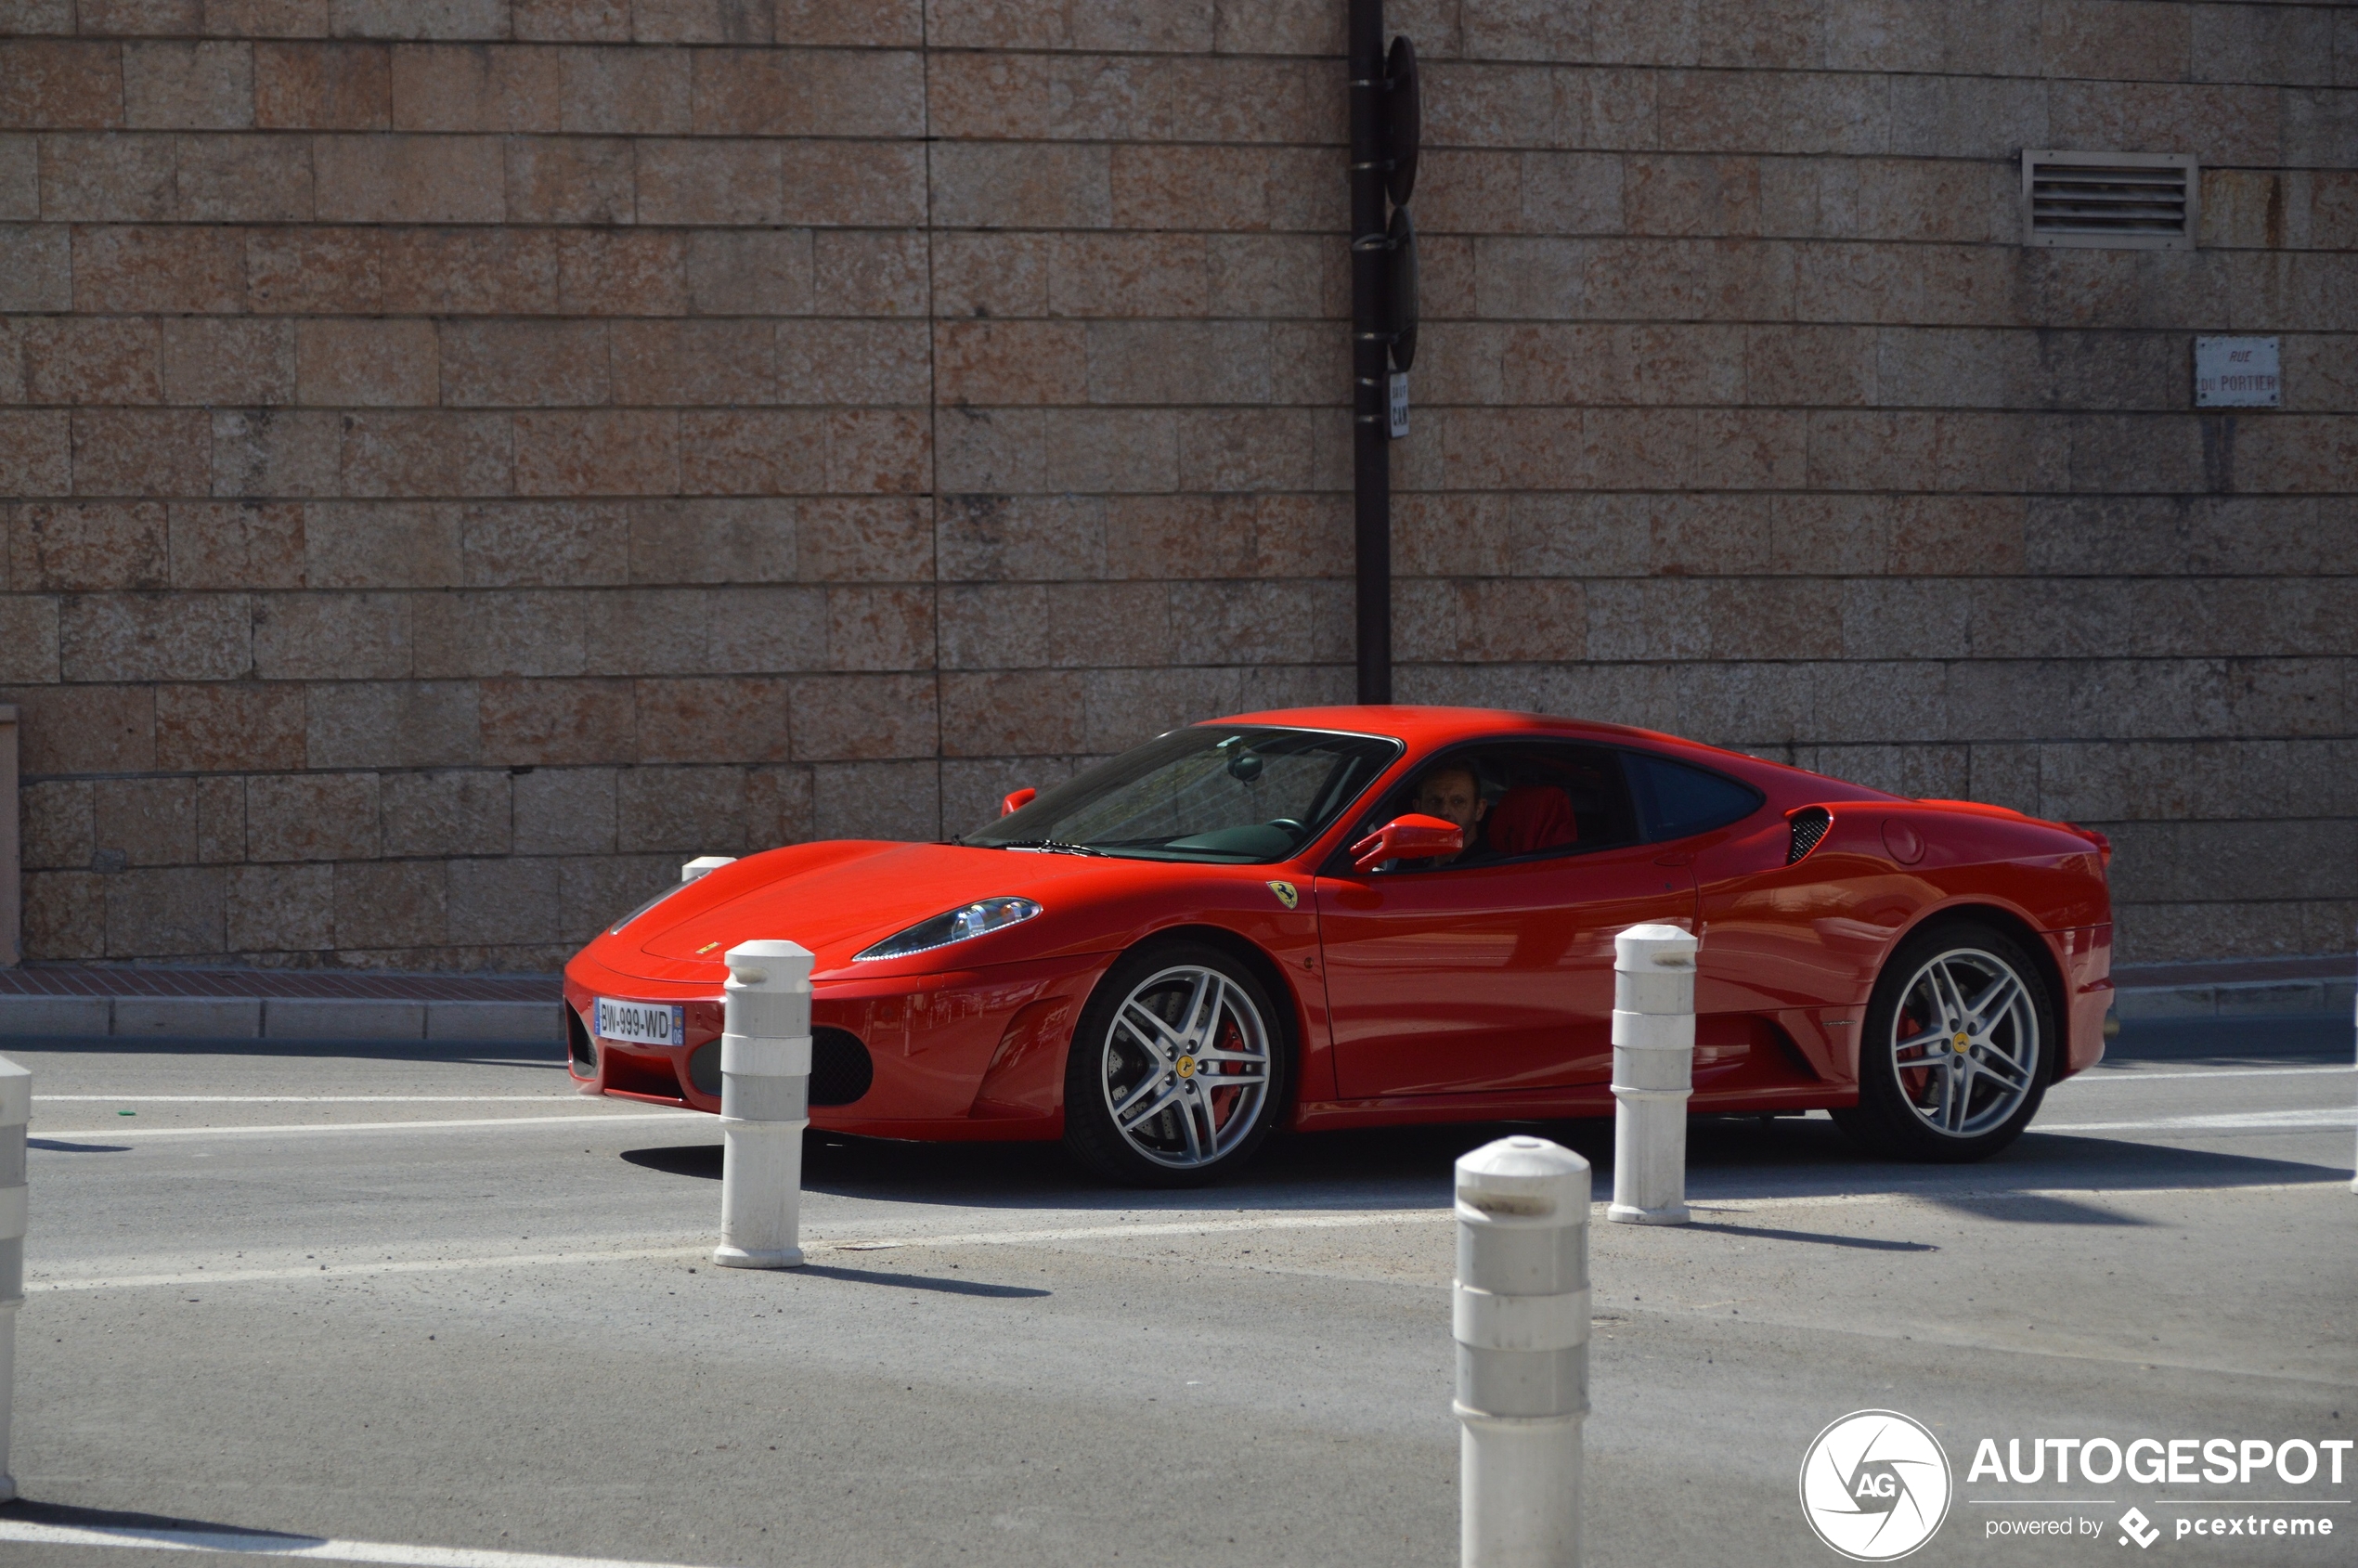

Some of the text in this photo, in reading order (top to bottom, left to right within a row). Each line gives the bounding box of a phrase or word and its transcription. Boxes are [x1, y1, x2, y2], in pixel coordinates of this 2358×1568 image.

[2230, 351, 2252, 362] RUE
[2201, 375, 2275, 392] DU PORTIER
[601, 1004, 668, 1039] BW-999-WD
[672, 1029, 683, 1044] 06
